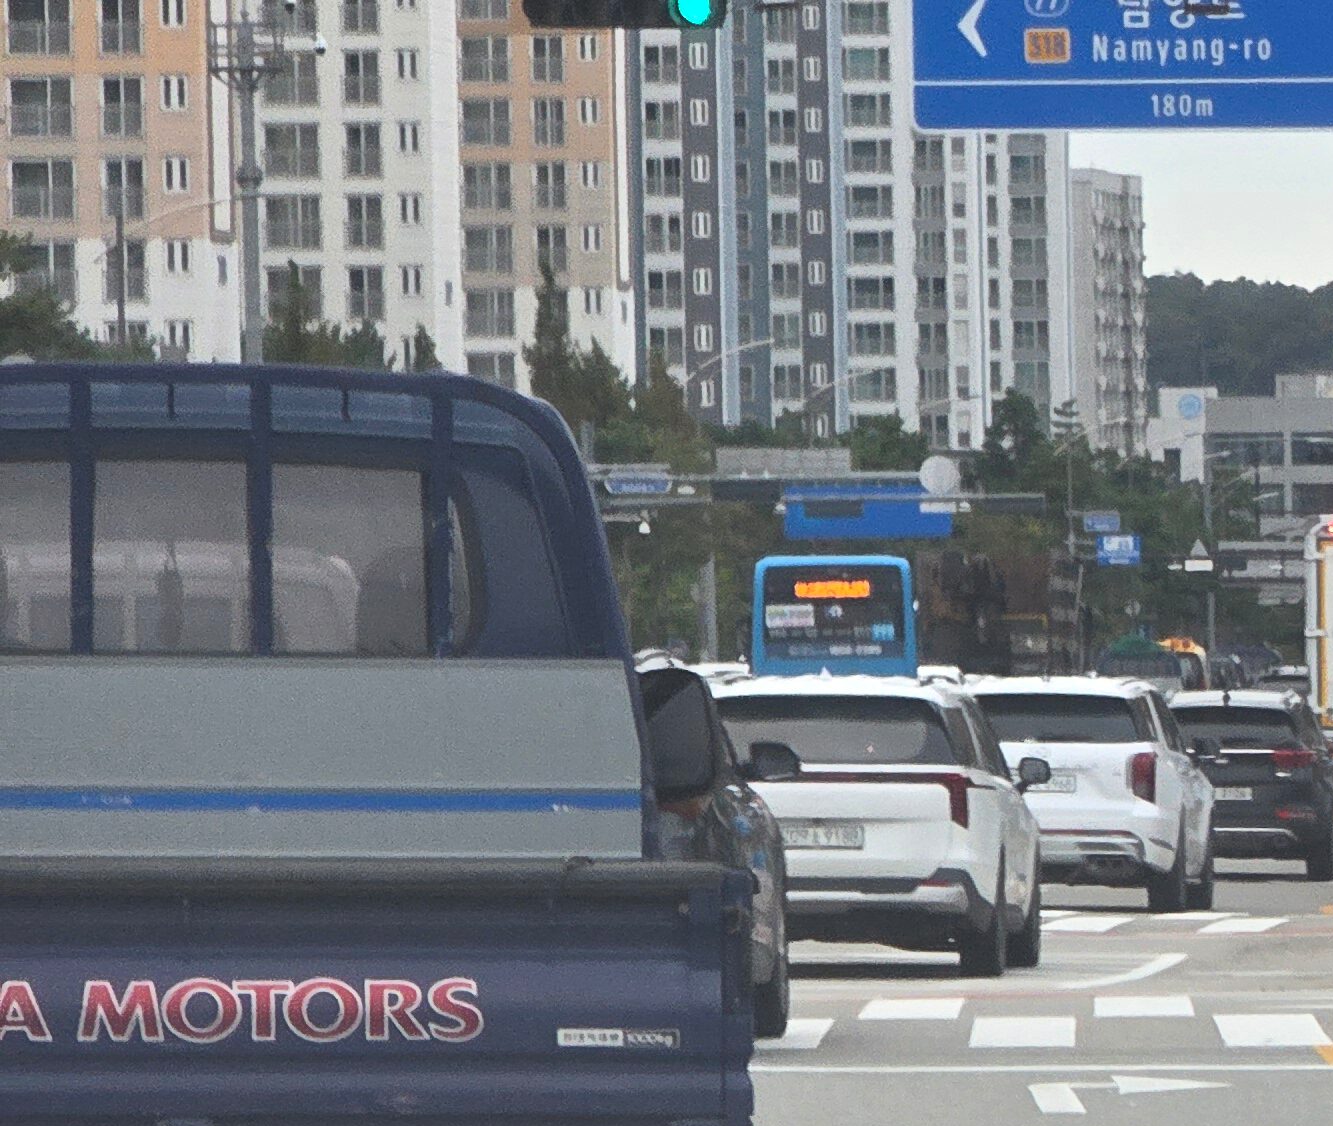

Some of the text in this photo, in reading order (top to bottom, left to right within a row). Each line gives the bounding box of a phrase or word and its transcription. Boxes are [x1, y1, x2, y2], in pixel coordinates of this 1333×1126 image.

[1092, 34, 1272, 66] Namyang-ro
[1151, 93, 1214, 117] 180m
[77, 977, 485, 1043] MOTORS
